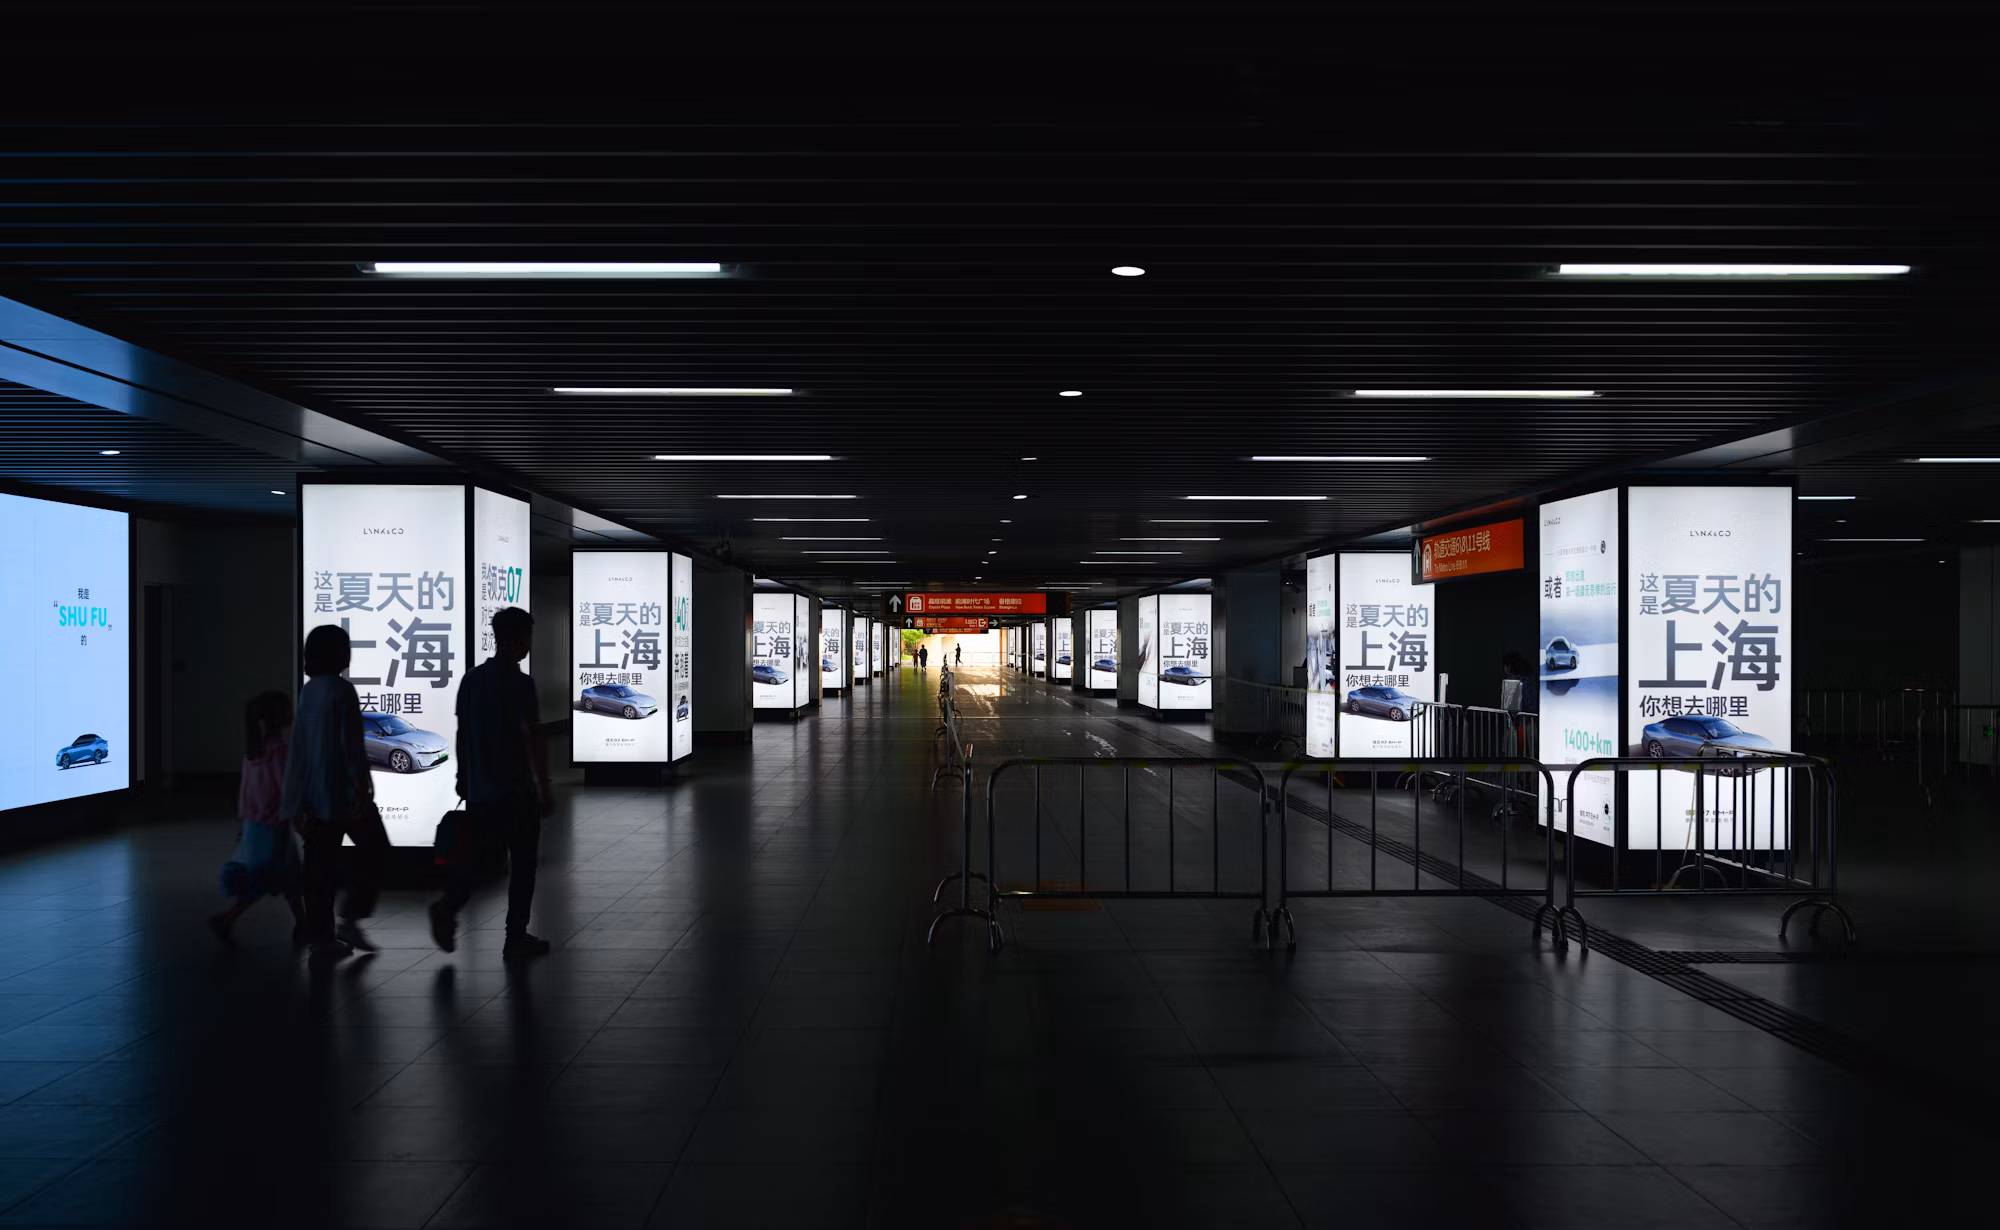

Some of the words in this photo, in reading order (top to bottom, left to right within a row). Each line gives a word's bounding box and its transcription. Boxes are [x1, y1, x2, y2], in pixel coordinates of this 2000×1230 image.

[1448, 561, 1456, 571] Line
[78, 588, 90, 600] 我是
[335, 570, 455, 613] 夏天的
[486, 563, 522, 604] 领克07
[1544, 575, 1563, 600] 或者
[1660, 572, 1782, 615] 夏天的
[591, 601, 662, 627] 夏天的
[1358, 603, 1429, 628] 夏天的
[753, 620, 791, 635] 夏天的
[1170, 621, 1209, 636] 夏天的
[80, 634, 87, 646] 的
[578, 628, 662, 671] 上海
[753, 635, 791, 659] 上海
[1162, 636, 1208, 659] 上海
[1345, 630, 1429, 673] 上海
[1638, 618, 1782, 692] 上海
[578, 672, 643, 687] 你想去哪里
[1345, 674, 1410, 689] 你想去哪里
[1638, 695, 1750, 719] 你想去哪里
[1564, 727, 1613, 756] 1400+km
